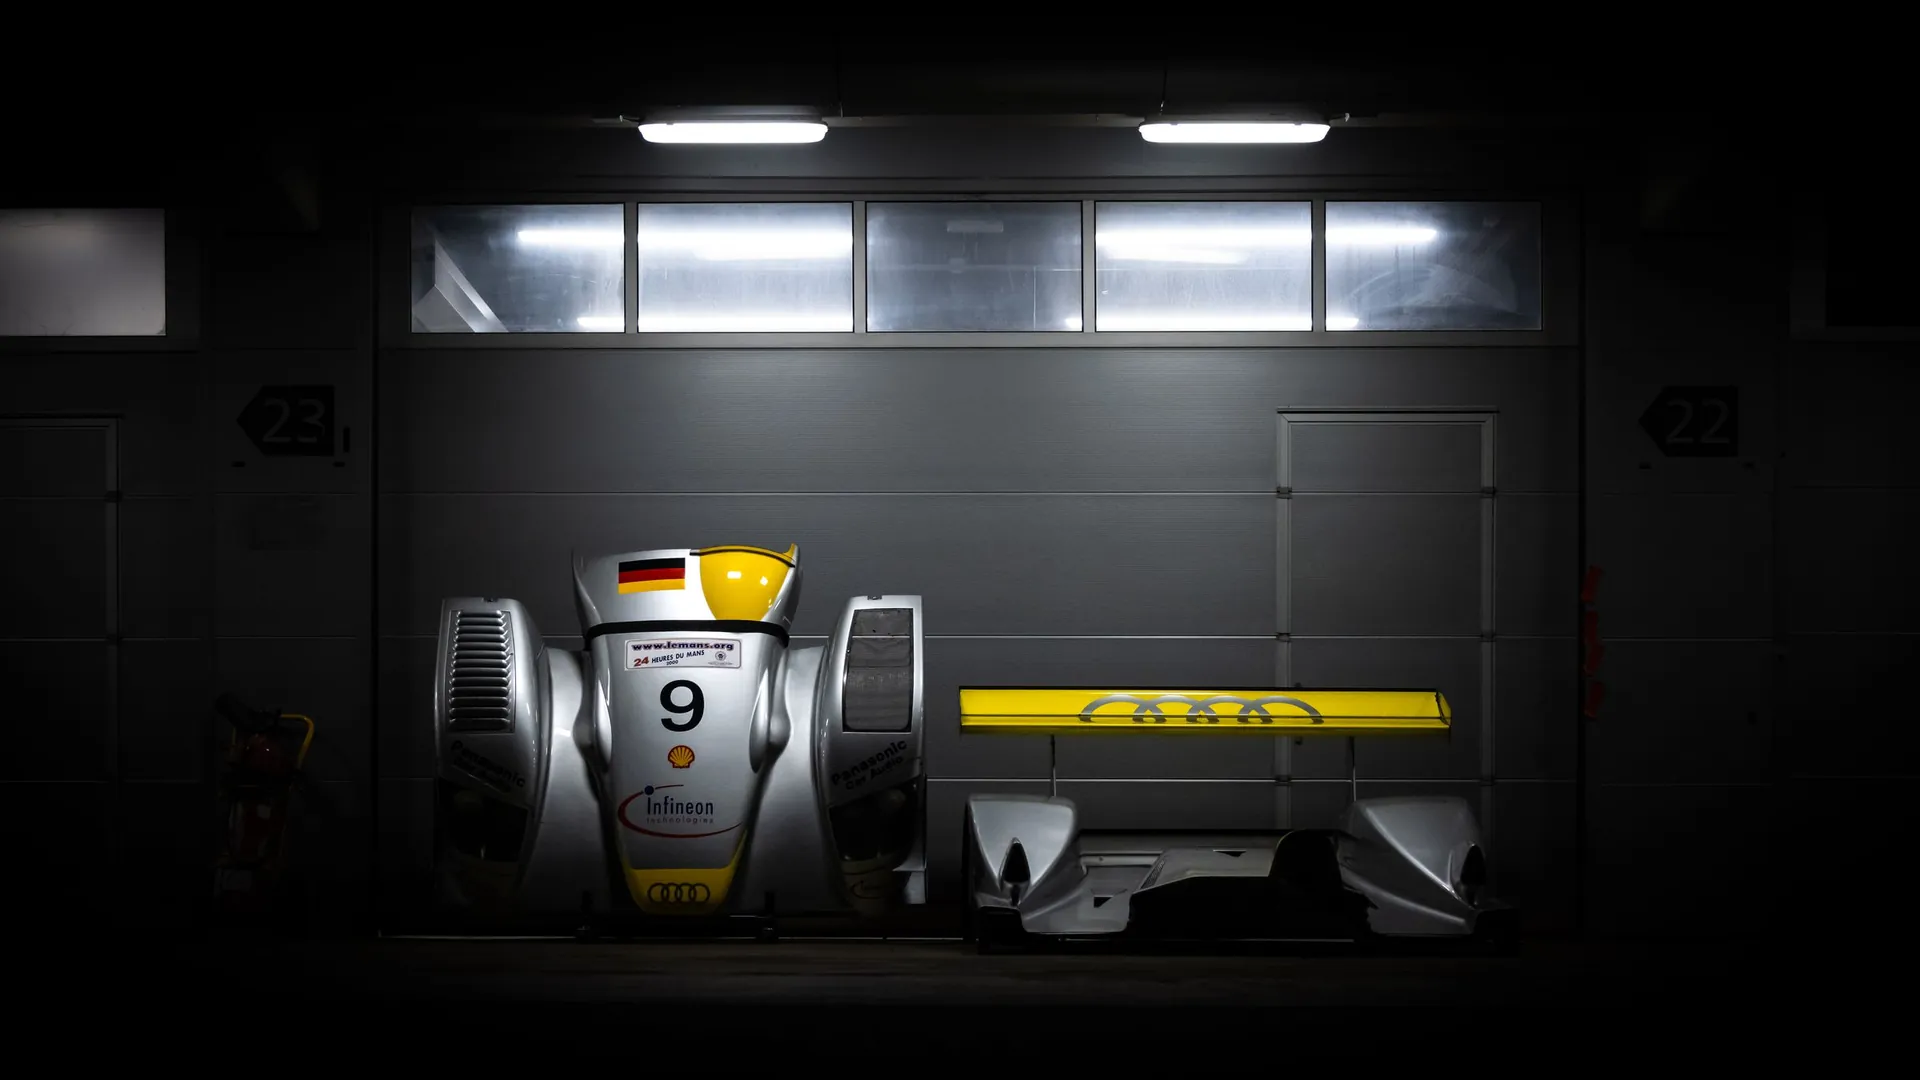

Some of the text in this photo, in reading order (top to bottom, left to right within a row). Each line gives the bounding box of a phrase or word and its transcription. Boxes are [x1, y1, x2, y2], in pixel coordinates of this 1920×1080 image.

[262, 397, 326, 444] 23
[1665, 397, 1731, 445] 22
[632, 641, 734, 651] www.lemans.org
[633, 657, 649, 667] 24
[651, 654, 673, 664] HEURES
[686, 649, 705, 658] MANS
[659, 680, 705, 733] 9
[831, 740, 907, 786] Panasonic
[846, 756, 904, 790] Car Audio
[646, 816, 714, 825] technologies
[647, 796, 714, 815] Infineon
